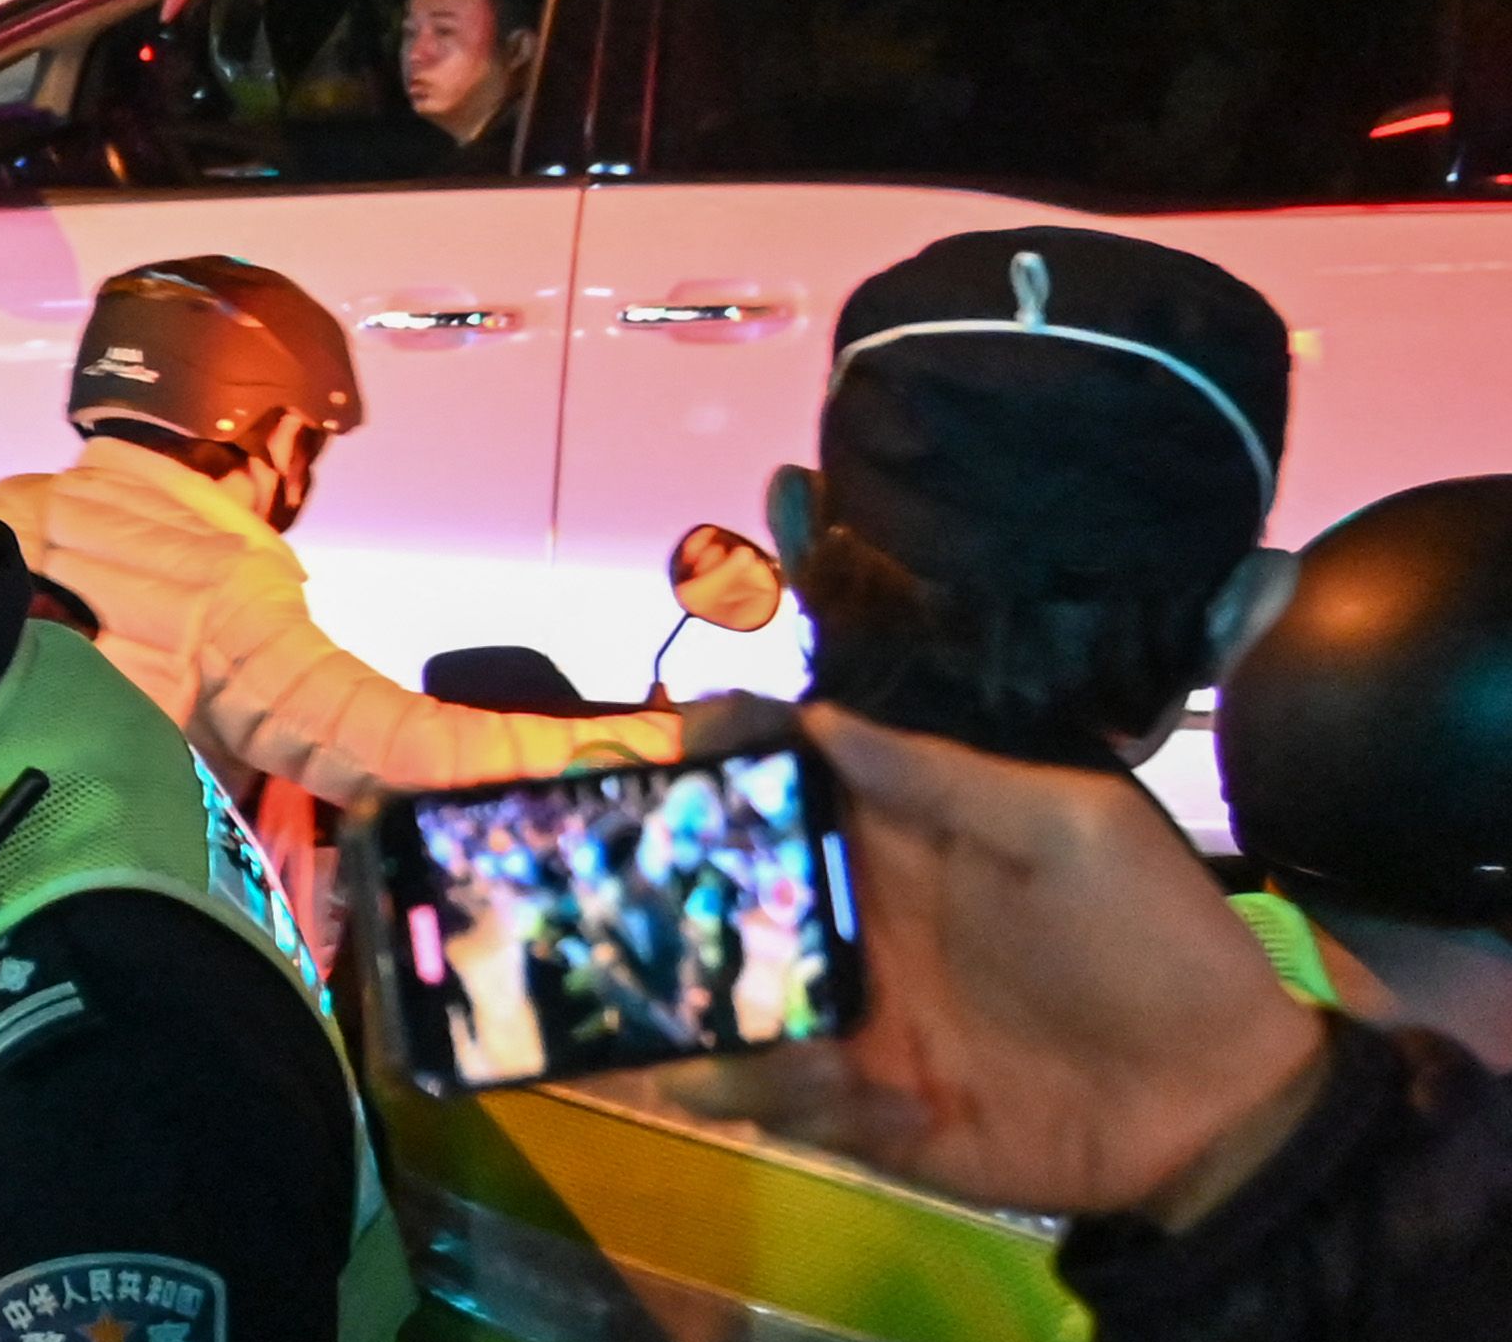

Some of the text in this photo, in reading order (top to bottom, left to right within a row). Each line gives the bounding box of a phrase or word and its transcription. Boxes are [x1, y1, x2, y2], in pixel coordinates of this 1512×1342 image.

[2, 1268, 204, 1330] 中华人民共和国
